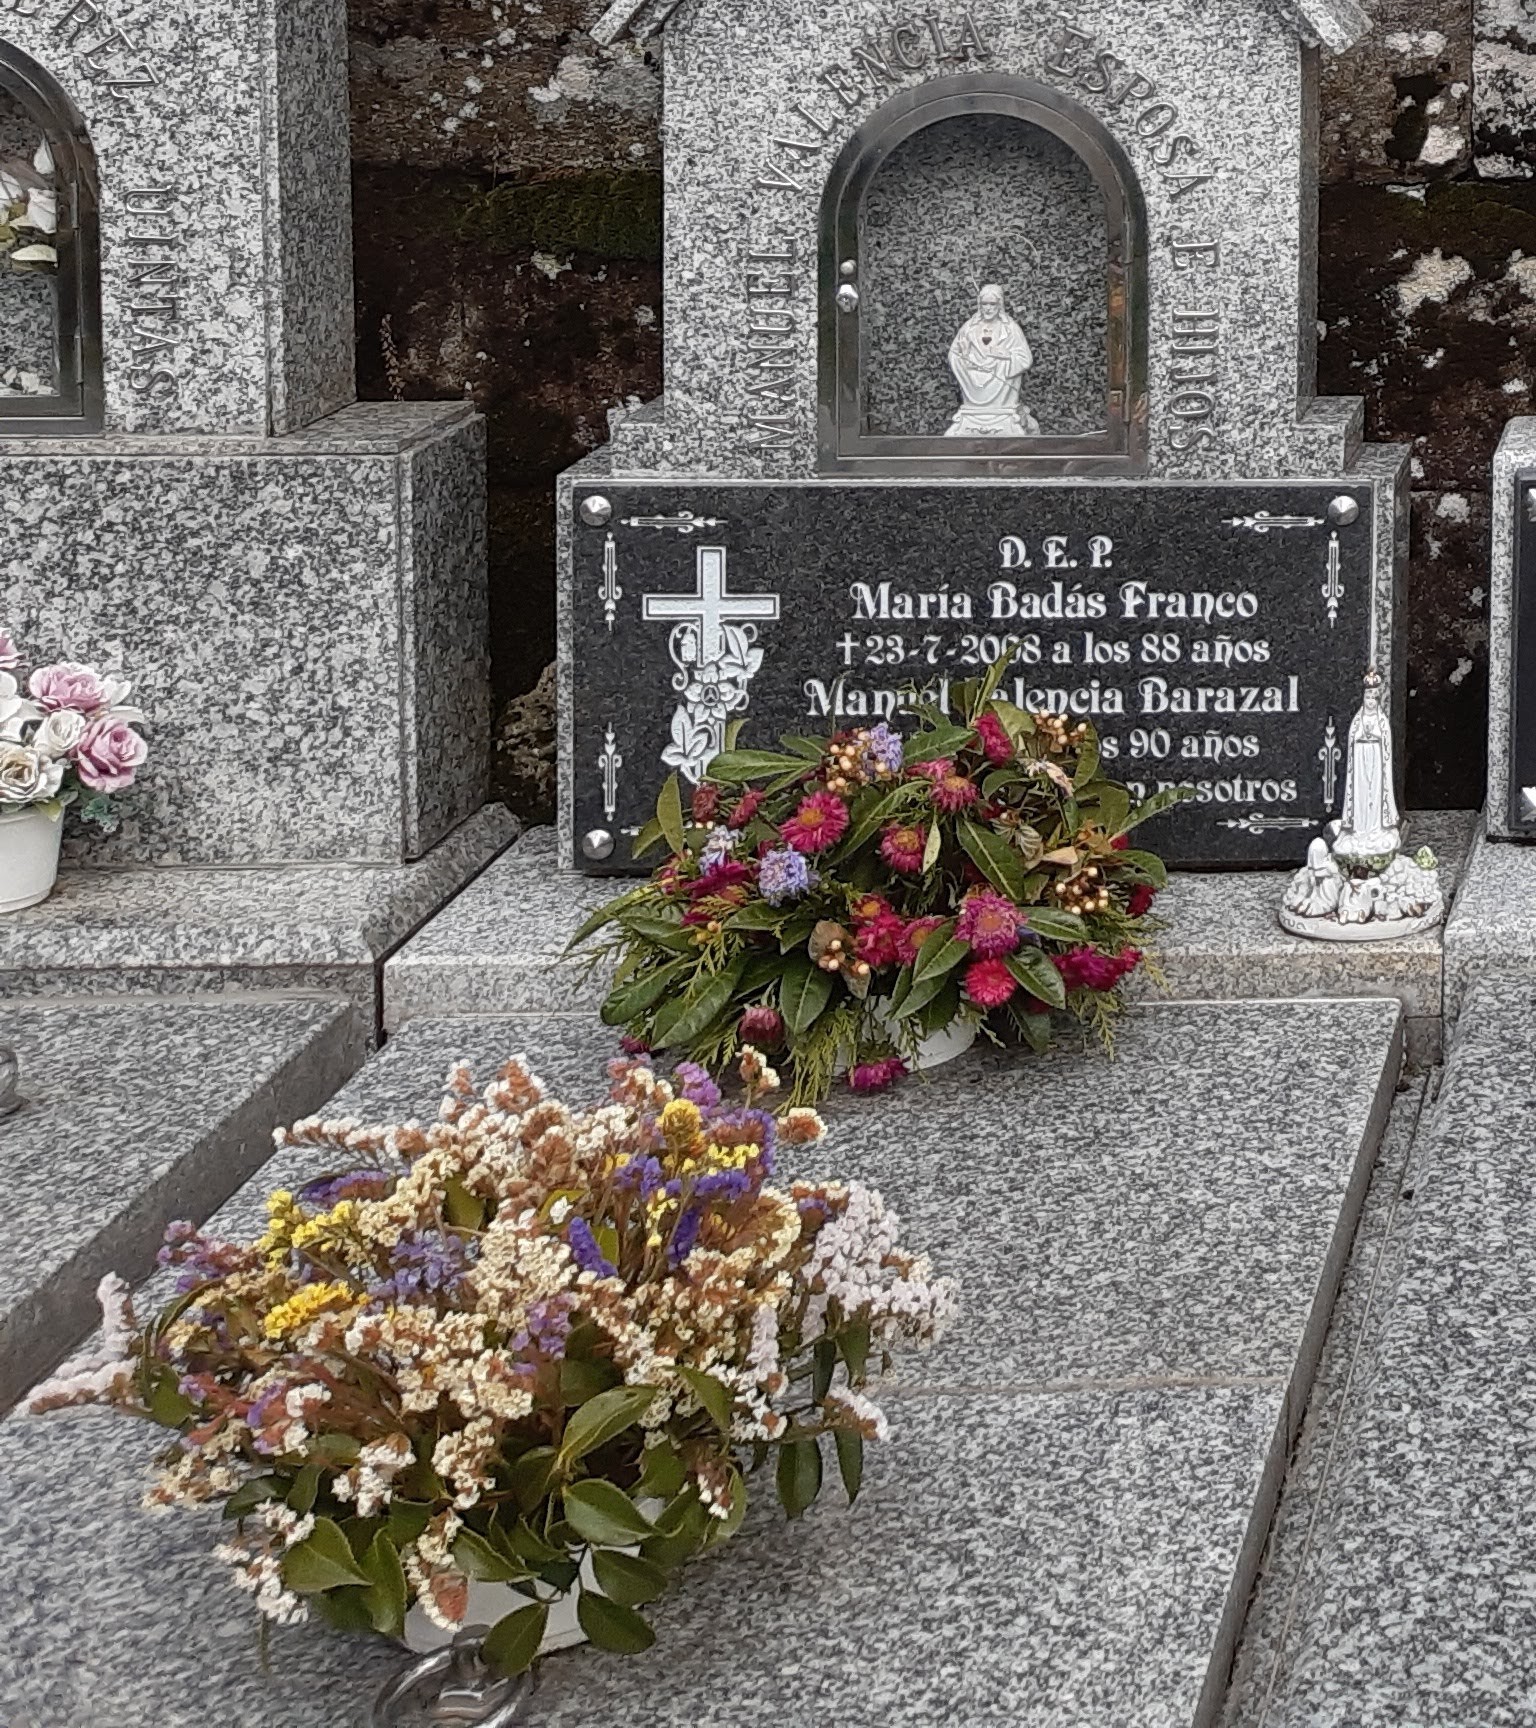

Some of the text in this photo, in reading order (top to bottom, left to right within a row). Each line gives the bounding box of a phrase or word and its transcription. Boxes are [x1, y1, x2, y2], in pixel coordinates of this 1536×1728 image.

[745, 12, 1220, 452] MANUEL VALENCIA ESPOSA E HIJOS
[1000, 536, 1114, 569] D. E. P.
[849, 580, 1259, 624] María Badás Franco
[1051, 638, 1073, 665] a
[1084, 631, 1131, 665] los
[1140, 632, 1182, 665] 88
[1190, 633, 1272, 669] años
[962, 675, 1126, 721] alencia
[1137, 674, 1300, 715] Barazal
[1129, 727, 1171, 759] 90
[1181, 728, 1261, 766] años
